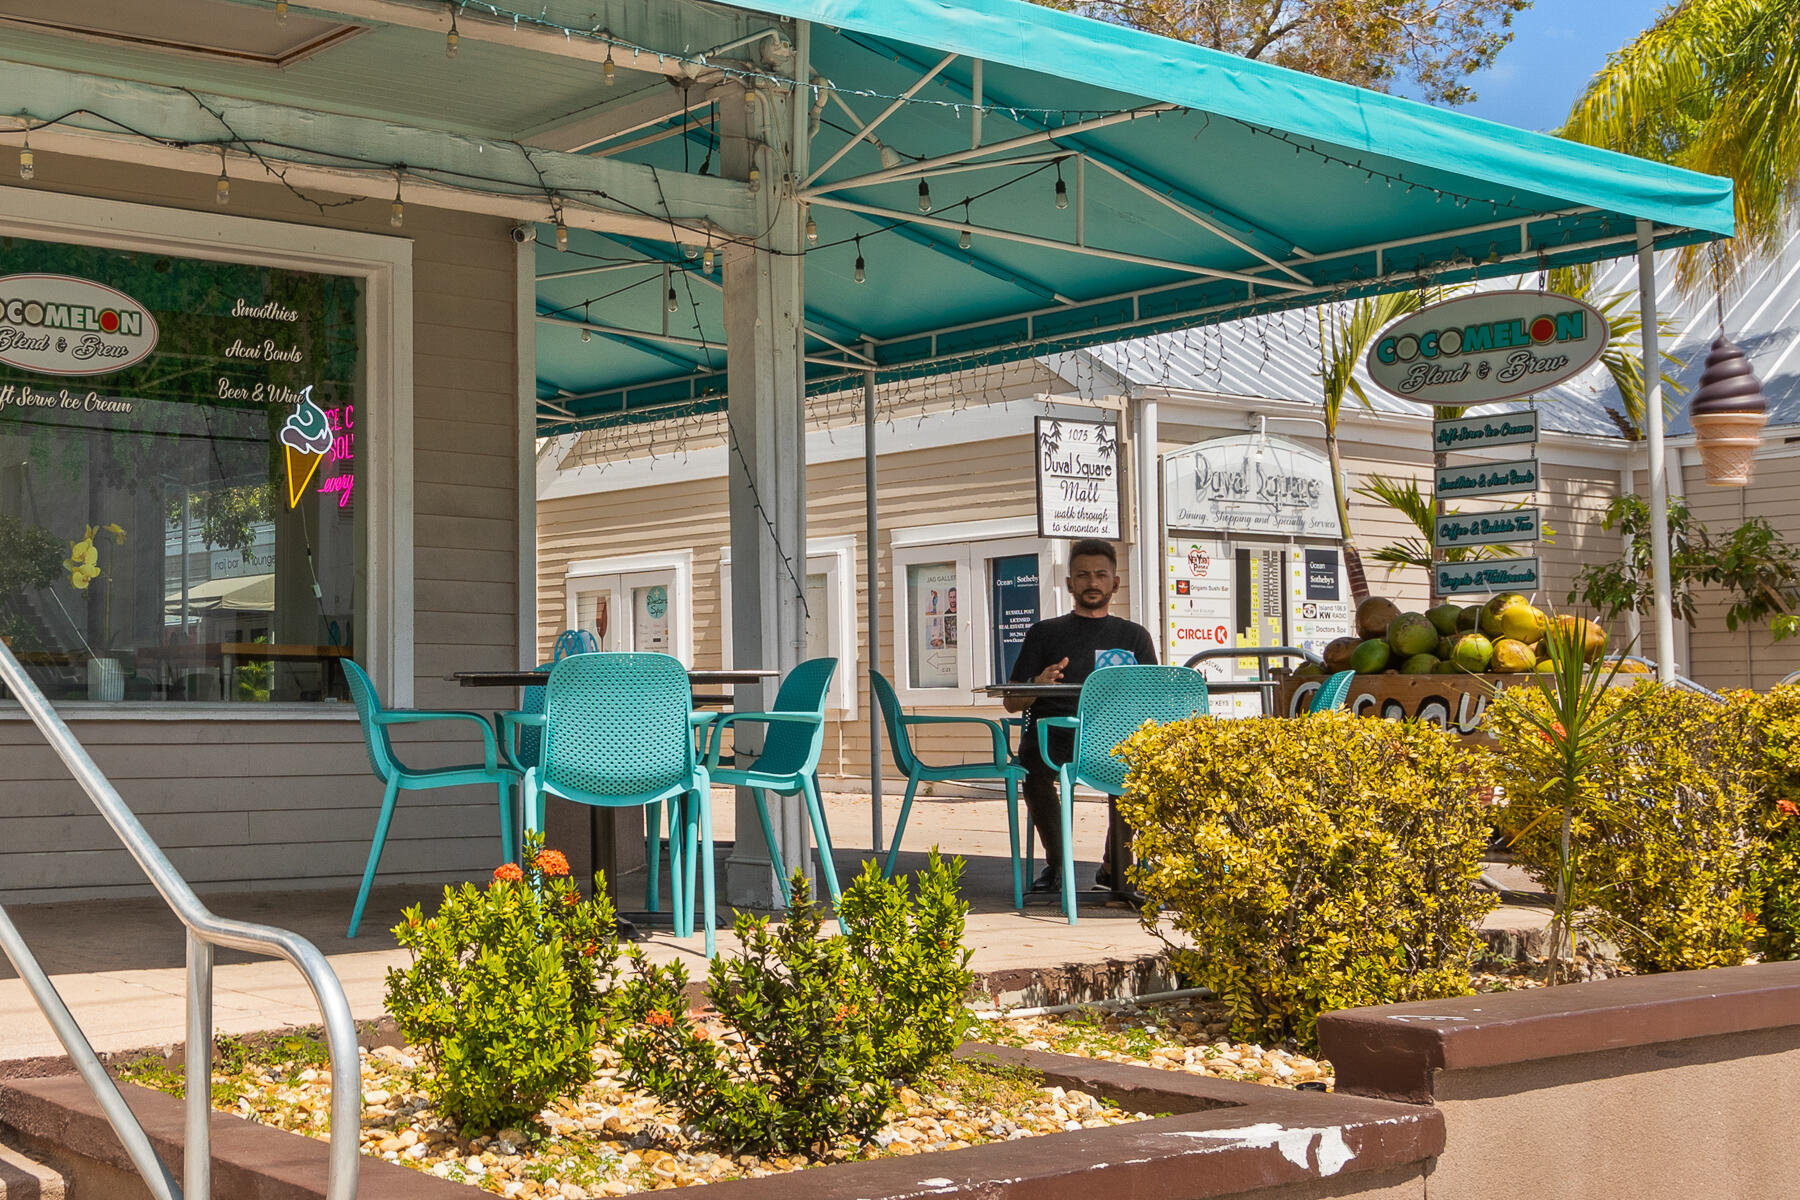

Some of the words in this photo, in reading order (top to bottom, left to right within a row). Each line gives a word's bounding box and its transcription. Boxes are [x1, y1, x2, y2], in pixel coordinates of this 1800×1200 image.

[0, 298, 142, 336] COMELON
[231, 298, 299, 322] Smoothies
[0, 326, 50, 352] Blend
[55, 336, 68, 352] &
[72, 334, 129, 360] Brew
[1377, 310, 1587, 366] COCOMELON
[225, 339, 261, 359] Acai
[263, 340, 302, 363] Bowls
[1398, 362, 1471, 394] Blend
[1476, 361, 1492, 379] &
[1496, 350, 1568, 383] Brew
[0, 384, 14, 411] ft
[16, 386, 57, 407] Serve
[59, 389, 81, 410] Ice
[84, 391, 133, 413] Cream
[218, 377, 249, 400] Beer
[251, 383, 264, 402] &
[267, 384, 306, 404] Wine
[1068, 428, 1088, 441] 1075
[1457, 426, 1484, 442] Serve
[1500, 422, 1534, 437] Cream
[331, 434, 354, 462] SOL
[1044, 451, 1073, 474] Duval
[1076, 454, 1113, 483] Square
[1060, 480, 1100, 503] Mall
[1195, 453, 1250, 495] Duval
[1256, 461, 1323, 513] Square
[1438, 476, 1477, 491] Smoothies
[1478, 473, 1486, 488] &
[1509, 469, 1535, 485] Bowls
[1054, 506, 1075, 520] walk
[1076, 507, 1109, 525] through
[1213, 511, 1252, 528] Shopping
[1254, 516, 1270, 526] and
[1273, 515, 1305, 529] Specialty
[1053, 522, 1060, 532] to
[1063, 523, 1099, 534] simonton
[1439, 523, 1469, 541] Coffee
[1470, 521, 1480, 535] &
[1480, 518, 1515, 534] Bubble
[1515, 516, 1534, 531] Tea
[1309, 561, 1326, 569] Ocean
[1310, 575, 1335, 585] Sotheby's
[1474, 571, 1484, 586] &
[1177, 628, 1213, 640] CIRCLE
[1215, 626, 1228, 644] K
